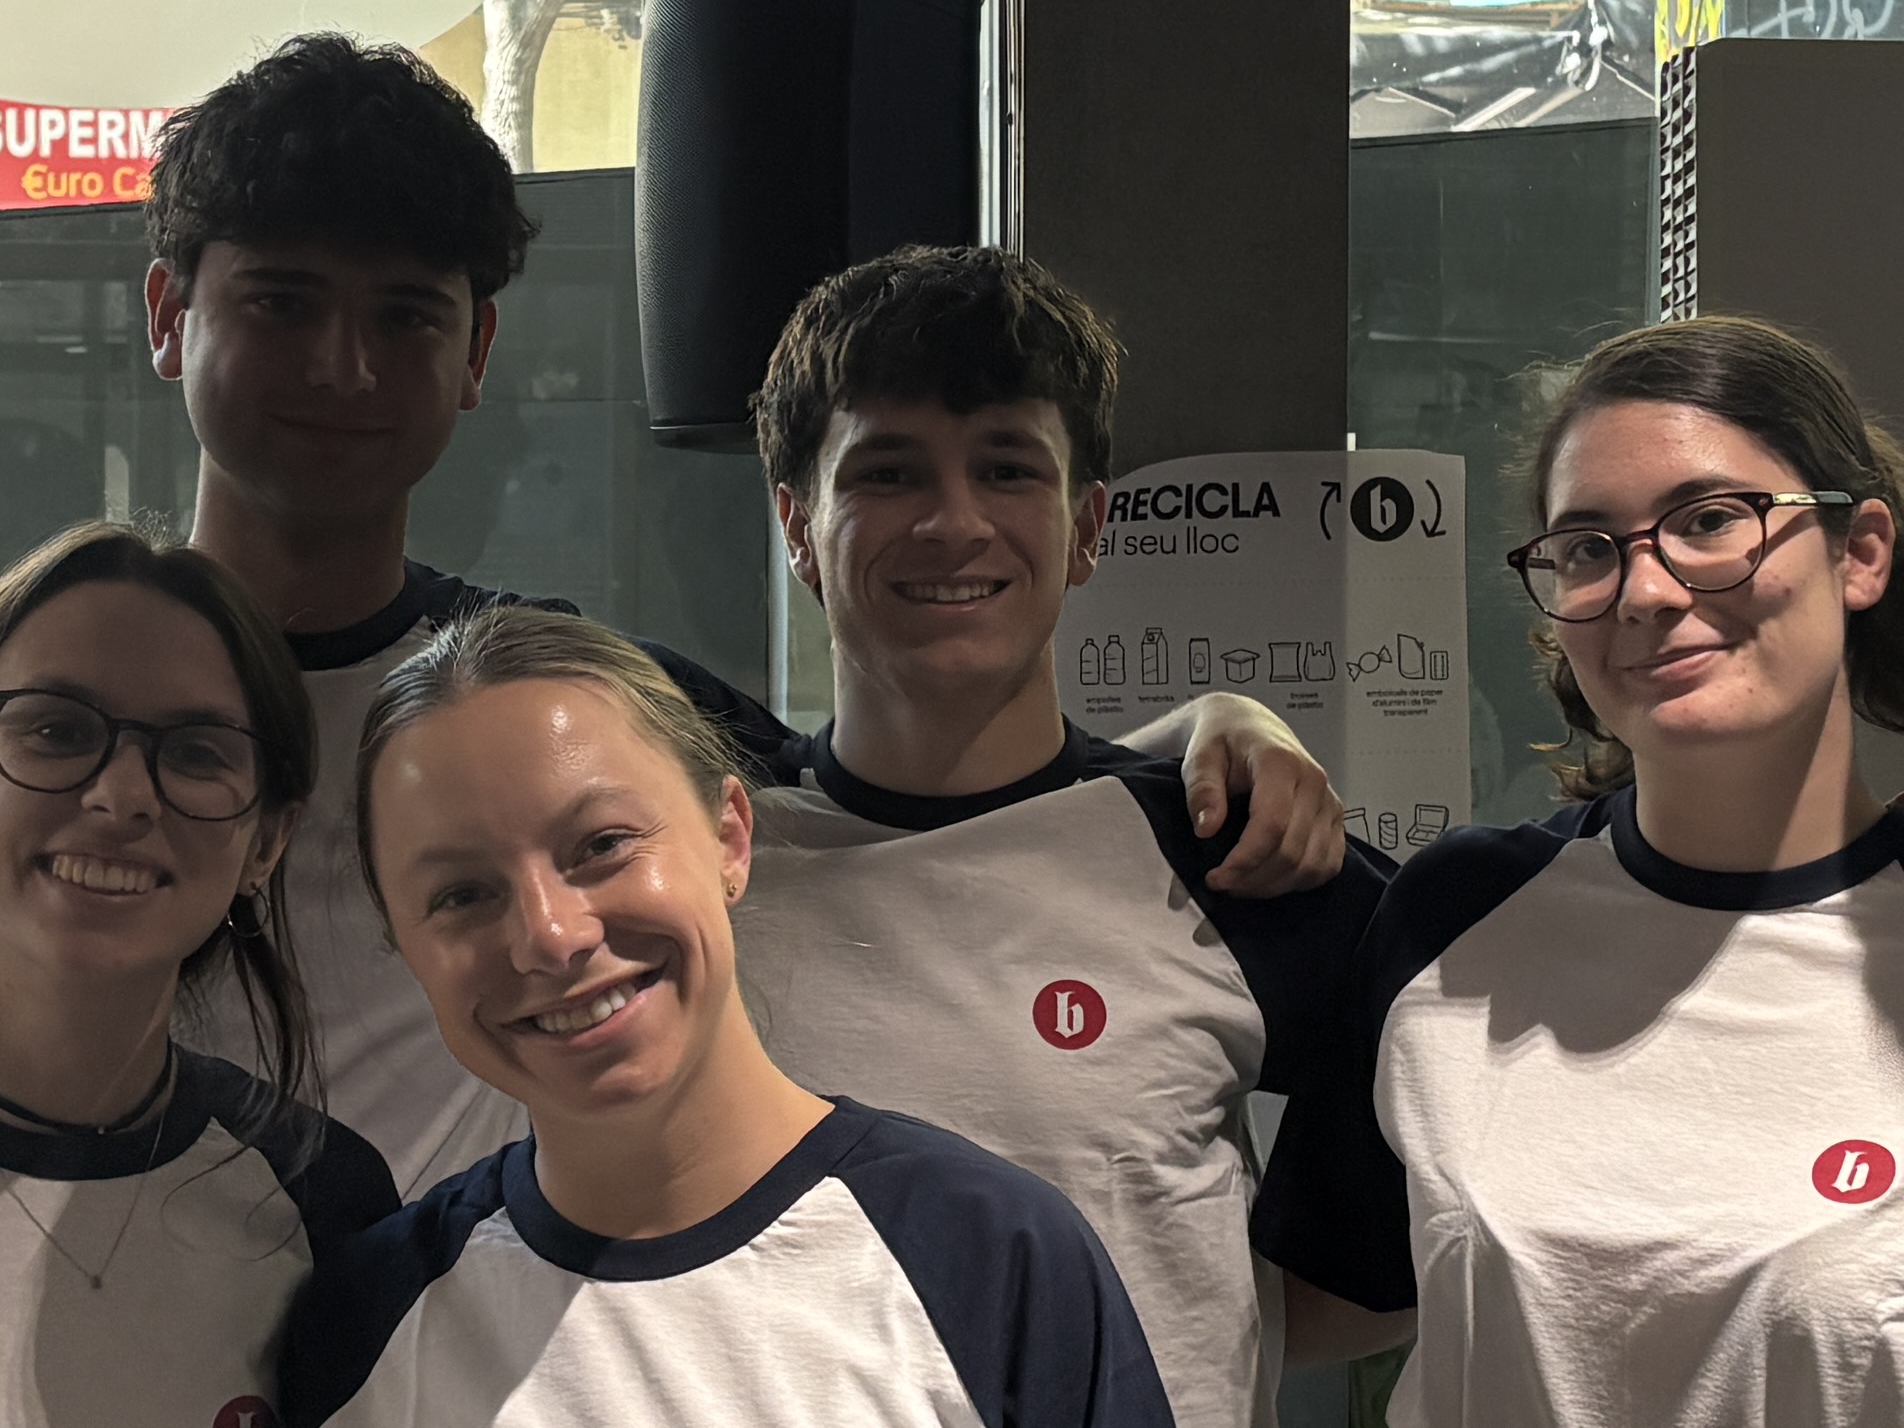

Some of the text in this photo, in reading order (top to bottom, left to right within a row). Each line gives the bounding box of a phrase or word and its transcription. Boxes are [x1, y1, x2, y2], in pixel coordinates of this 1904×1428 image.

[1106, 481, 1281, 523] RECICLA
[1123, 534, 1177, 556] seu
[1185, 526, 1241, 555] lloc
